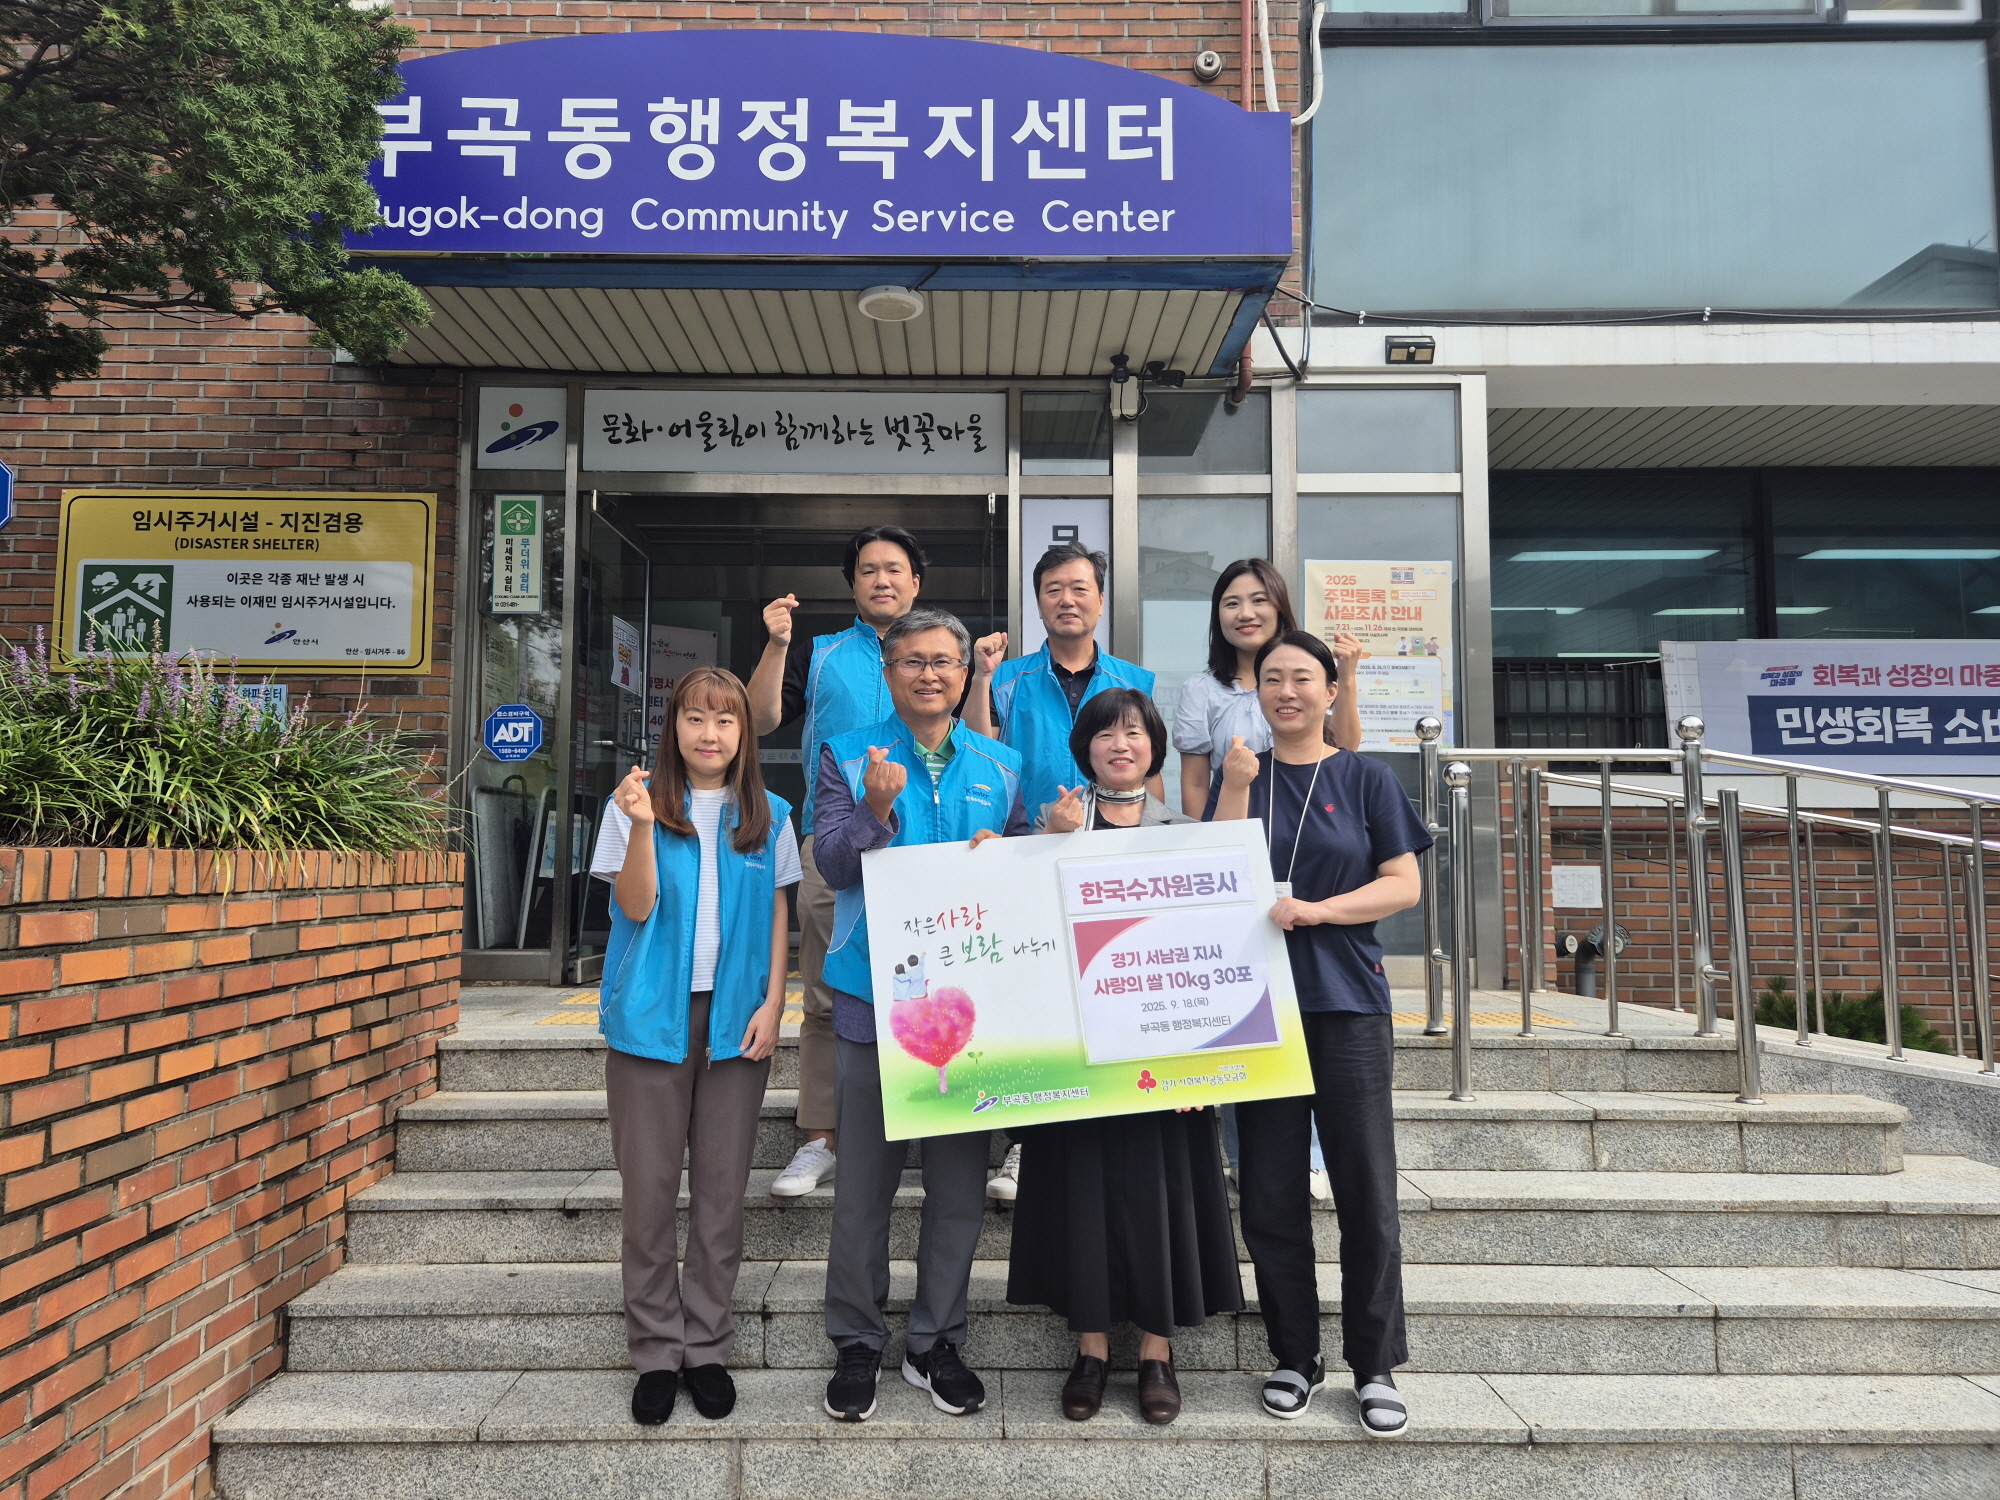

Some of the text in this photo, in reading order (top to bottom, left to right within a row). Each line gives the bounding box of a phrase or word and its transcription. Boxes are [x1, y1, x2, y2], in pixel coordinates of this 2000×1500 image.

[376, 95, 1174, 182] 부곡동행정복지센터
[370, 195, 1176, 239] ugok-dong Community Service Center
[775, 410, 876, 451] 함께하는
[132, 509, 260, 533] 임시주거시설
[280, 511, 364, 534] 지진겸용
[174, 536, 320, 553] (DISASTER SHELTER)
[504, 538, 514, 593] 미세먼지 쉼터
[520, 538, 531, 594] 무더위 쉼터
[226, 572, 365, 587] 이곳은 각종 재난 발생 시
[1325, 574, 1357, 586] 2025
[186, 594, 397, 610] 사용되는 이재민 임시주거시설입니다.
[1324, 588, 1386, 604] 주민등록
[1324, 605, 1422, 621] 사실조사 안내
[292, 638, 319, 646] 안산시
[396, 648, 406, 656] 86
[1812, 663, 1882, 687] 회복과
[1886, 664, 1954, 688] 성장의
[493, 722, 533, 743] ADT
[1776, 705, 1933, 745] 민생회복
[1079, 870, 1238, 905] 한국수자원공사
[903, 902, 989, 937] 작은 사랑
[938, 933, 1057, 966] 큰 보람 나누기
[1110, 944, 1223, 969] 경기 서남권 지사
[1093, 966, 1253, 997] 사랑의 쌀 10kg 30포
[1141, 1002, 1168, 1013] 2025.
[1170, 1000, 1180, 1010] 9.
[1139, 1015, 1232, 1035] 부곡동 행정복지센터
[1002, 1087, 1090, 1107] 부곡동 행정복지센터
